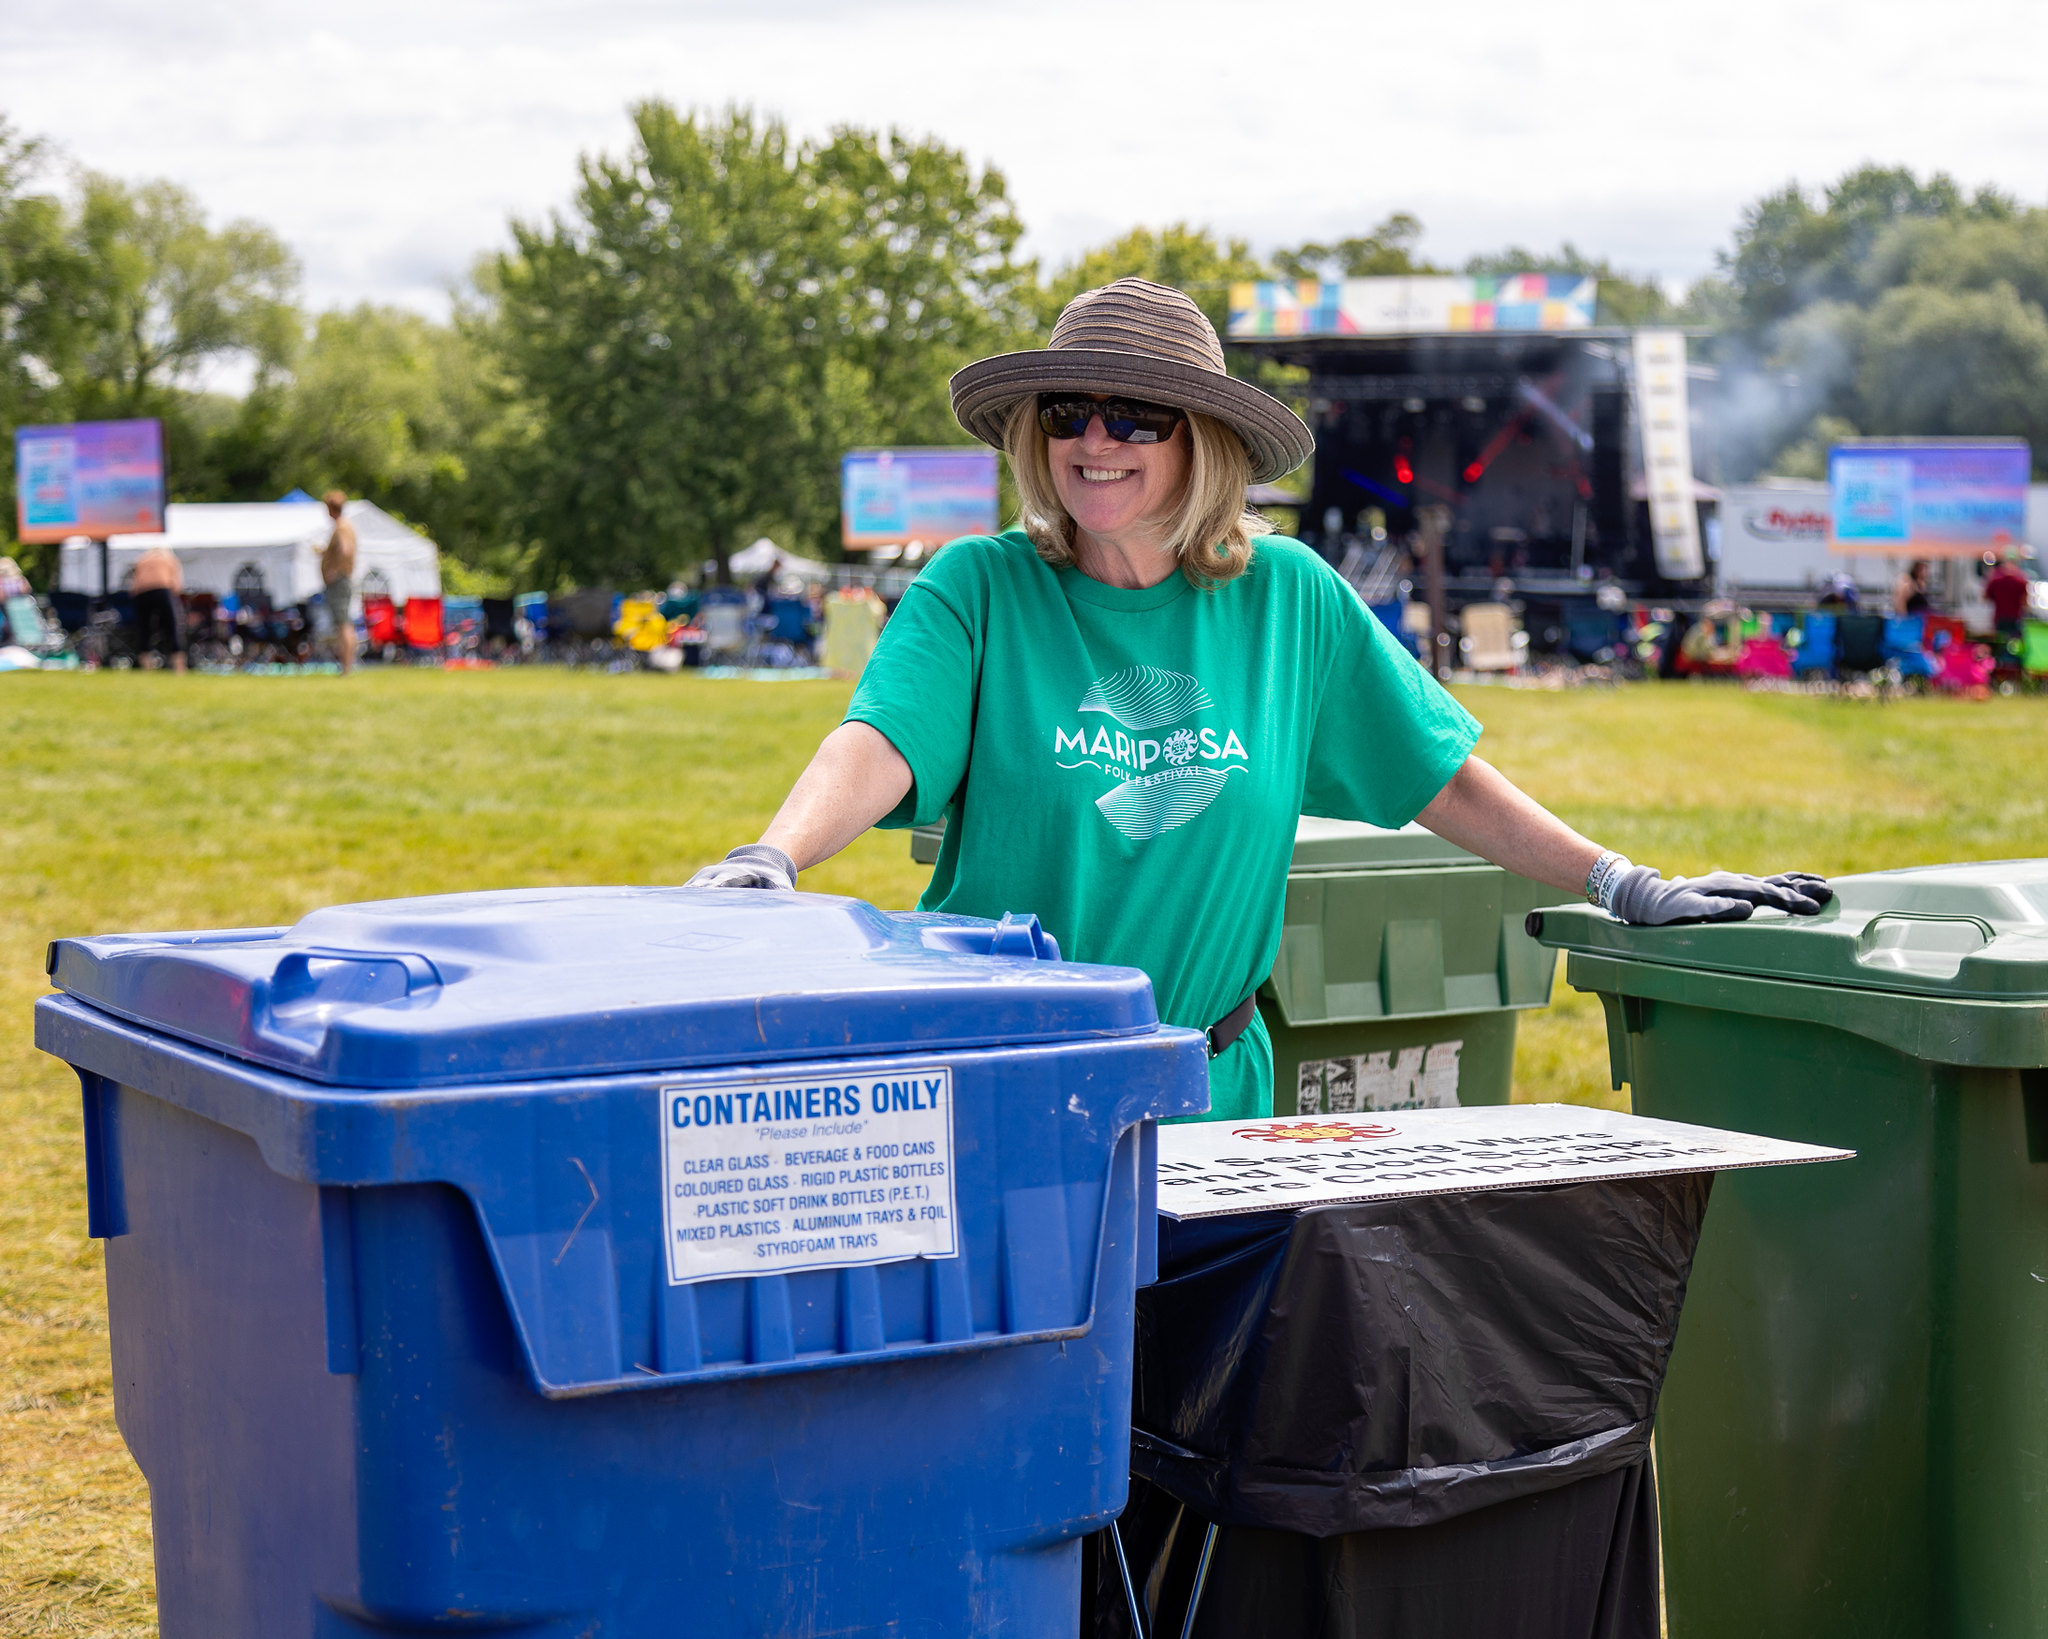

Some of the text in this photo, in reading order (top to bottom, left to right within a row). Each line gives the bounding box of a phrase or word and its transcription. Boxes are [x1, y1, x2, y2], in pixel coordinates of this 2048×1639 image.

[1055, 725, 1249, 771] MARIPOSA
[1104, 763, 1202, 786] FOLK FESTIVAL
[672, 1079, 942, 1128] CONTAINERS ONLY
[684, 1140, 935, 1175] CLEAR GLASS BEVERAGE & FOOD CANS
[1157, 1139, 1671, 1186] and Food Scraps
[1214, 1143, 1460, 1167] Serving
[1456, 1132, 1613, 1148] Ware
[675, 1161, 945, 1198] COLOURED GLASS RIGID PLASTIC BOTTLES
[1206, 1147, 1727, 1197] are Compostable
[753, 1197, 786, 1214] SOFT
[789, 1193, 828, 1210] DRINK
[832, 1188, 885, 1207] BOTTLES
[888, 1184, 930, 1204] (P.E.T.)
[676, 1205, 948, 1243] MIXED PLASTICS ALUMINUM TRAYS & FOIL
[839, 1233, 878, 1250] TRAYS
